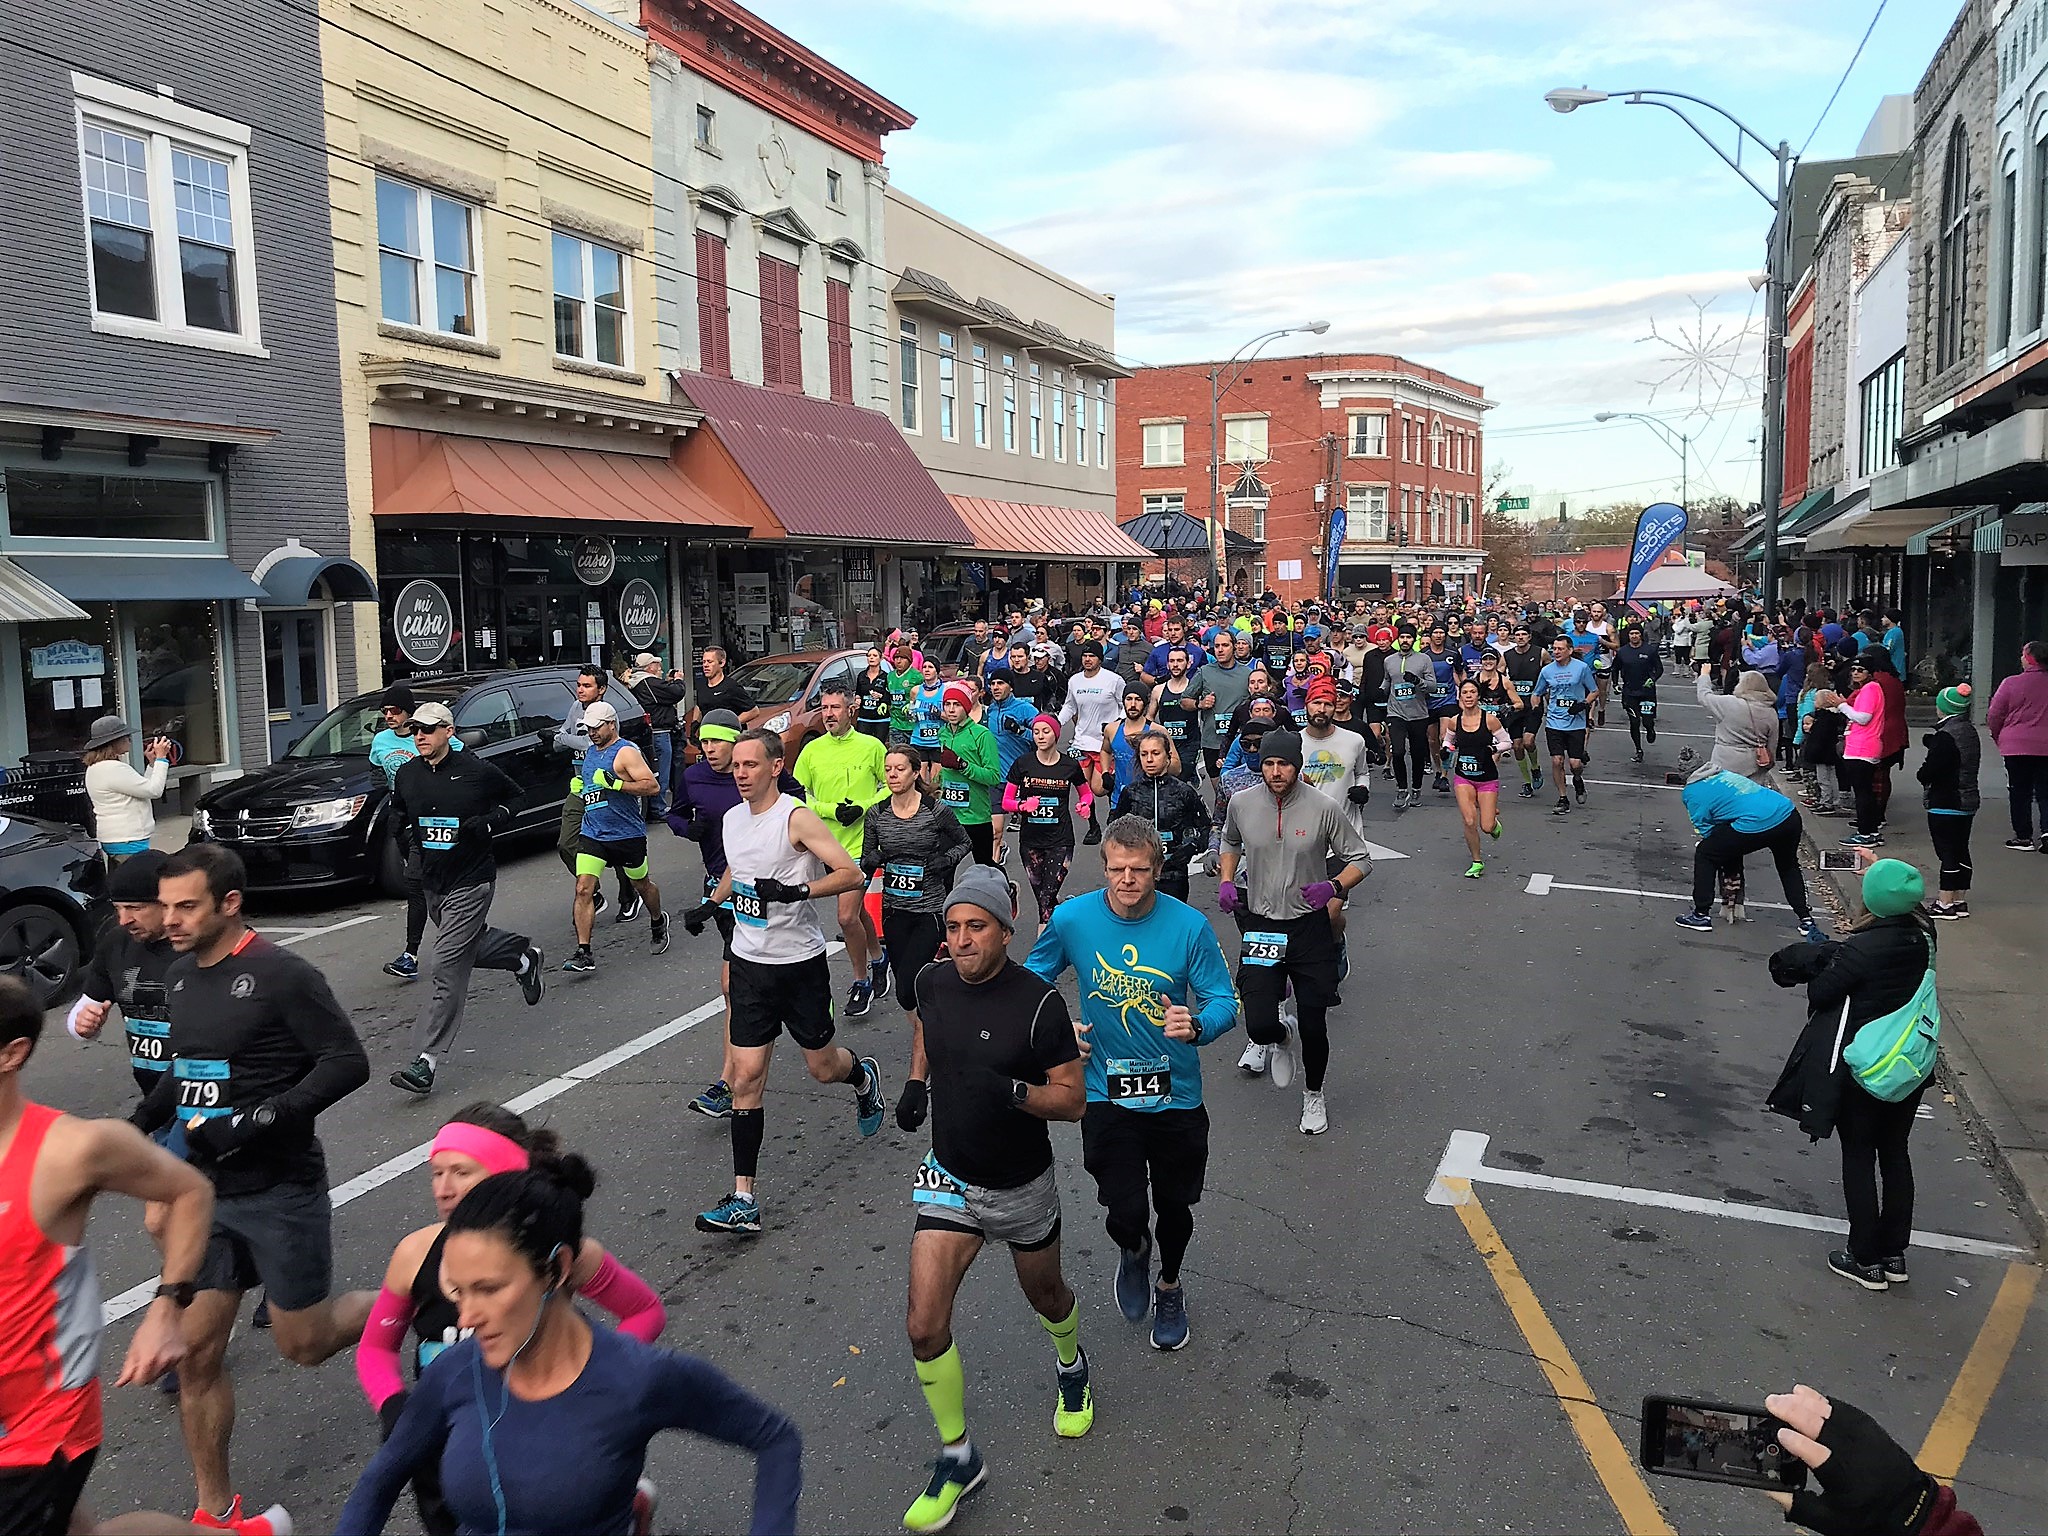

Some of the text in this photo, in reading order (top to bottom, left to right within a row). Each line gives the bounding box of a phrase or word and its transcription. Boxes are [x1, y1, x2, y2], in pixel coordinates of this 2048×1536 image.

[1507, 500, 1522, 508] OAK
[1638, 518, 1660, 543] GO!
[1633, 513, 1683, 566] SPORTS
[578, 553, 610, 568] casa
[413, 594, 434, 613] mi
[633, 591, 647, 606] mi
[625, 606, 657, 626] casa
[402, 613, 448, 637] casa
[411, 638, 439, 648] ON MAIN
[1559, 699, 1575, 707] 847
[923, 727, 938, 737] 503
[1168, 727, 1184, 736] 939
[573, 750, 587, 760] 94
[1461, 762, 1478, 772] 841
[66, 787, 87, 796] TRASH
[584, 790, 601, 805] 937
[945, 788, 965, 801] 885
[0, 795, 28, 806] RECYCLE
[426, 827, 452, 842] 516
[890, 874, 916, 890] 785
[736, 895, 761, 917] 888
[1248, 942, 1279, 959] 758
[1092, 967, 1155, 992] MAYBERRY
[131, 1035, 163, 1059] 740
[180, 1080, 220, 1107] 779
[1120, 1075, 1160, 1097] 514
[913, 1164, 956, 1191] 504
